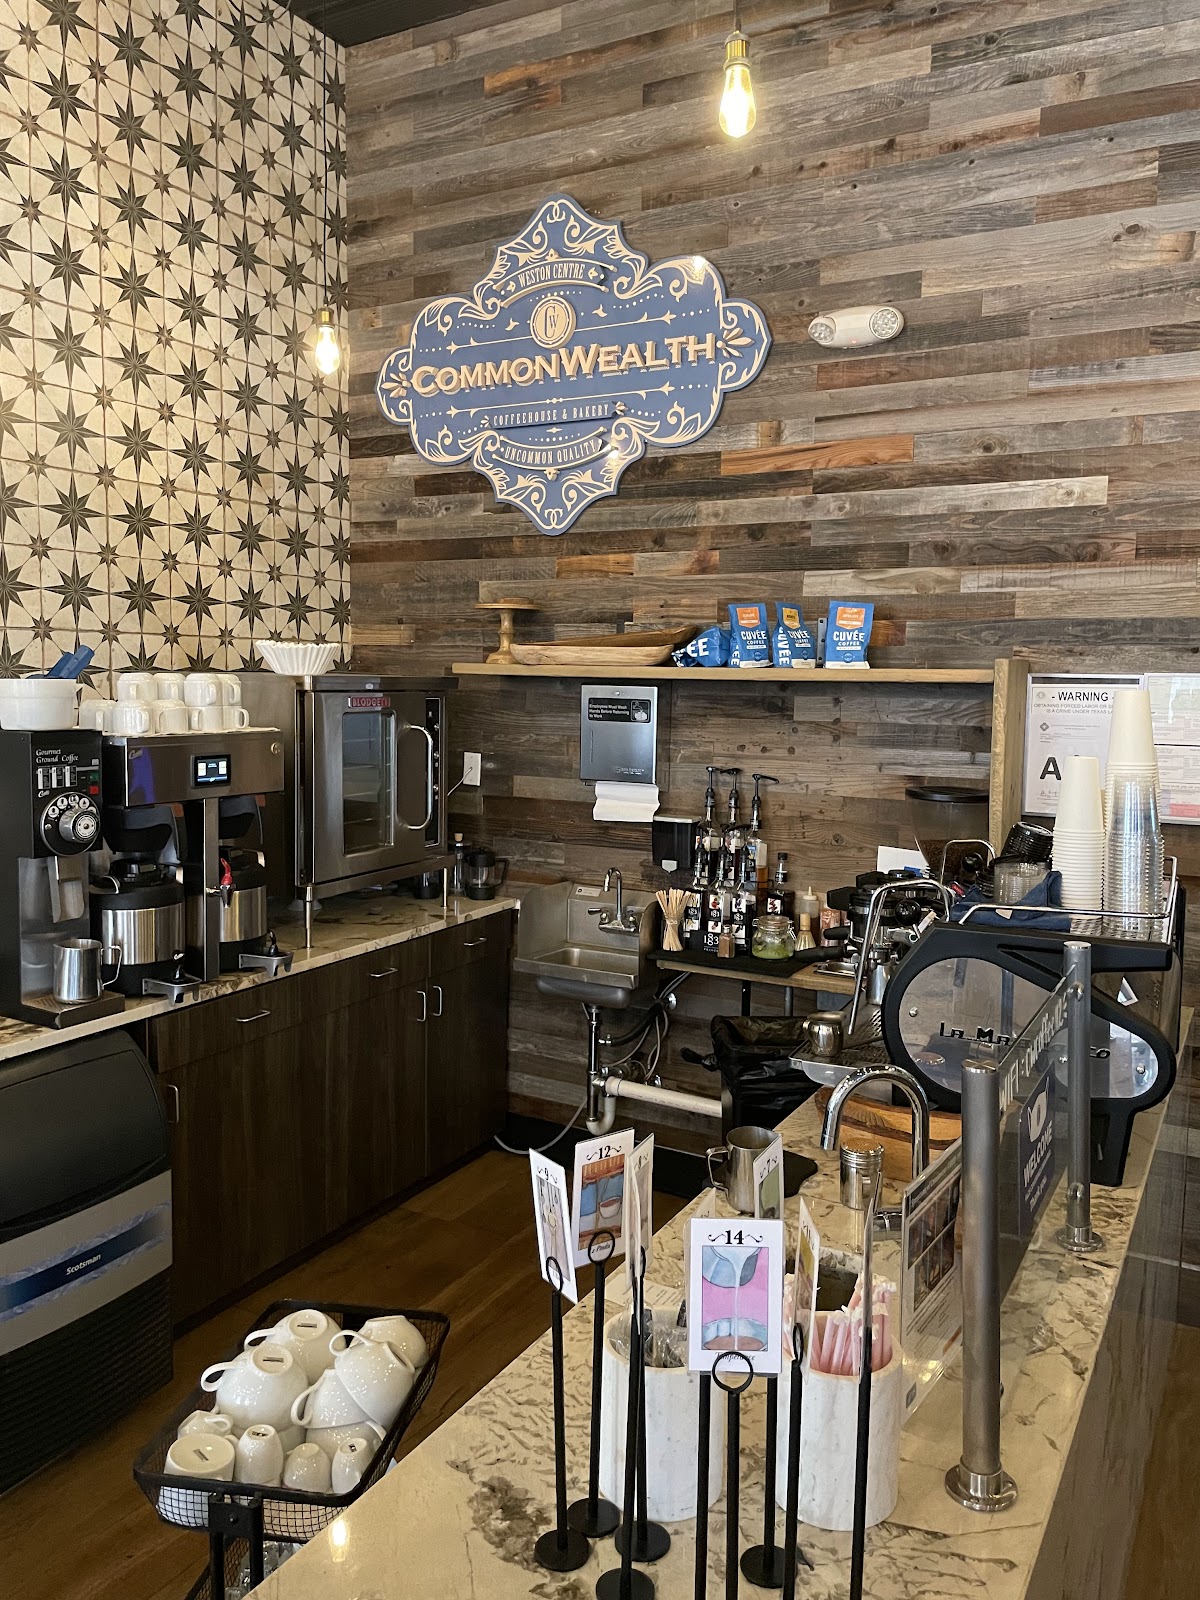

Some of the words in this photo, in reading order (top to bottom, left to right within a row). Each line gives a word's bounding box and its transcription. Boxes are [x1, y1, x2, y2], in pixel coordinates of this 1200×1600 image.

[518, 264, 551, 288] WESTON
[553, 263, 585, 279] CENTRE
[493, 410, 557, 426] COFFEEHOUSE
[562, 408, 567, 420] &
[573, 404, 609, 419] BAKERY
[504, 446, 553, 465] UNCOMMON
[557, 439, 596, 462] QUALITY
[1058, 691, 1109, 702] WARNING
[35, 748, 62, 756] Gourmet
[35, 755, 59, 764] Ground
[61, 753, 79, 764] Coffee
[1039, 756, 1062, 781] A
[598, 1145, 611, 1160] 12
[1023, 1120, 1052, 1188] WELCOME
[726, 1229, 745, 1245] 14
[66, 1254, 101, 1275] Scotsman
